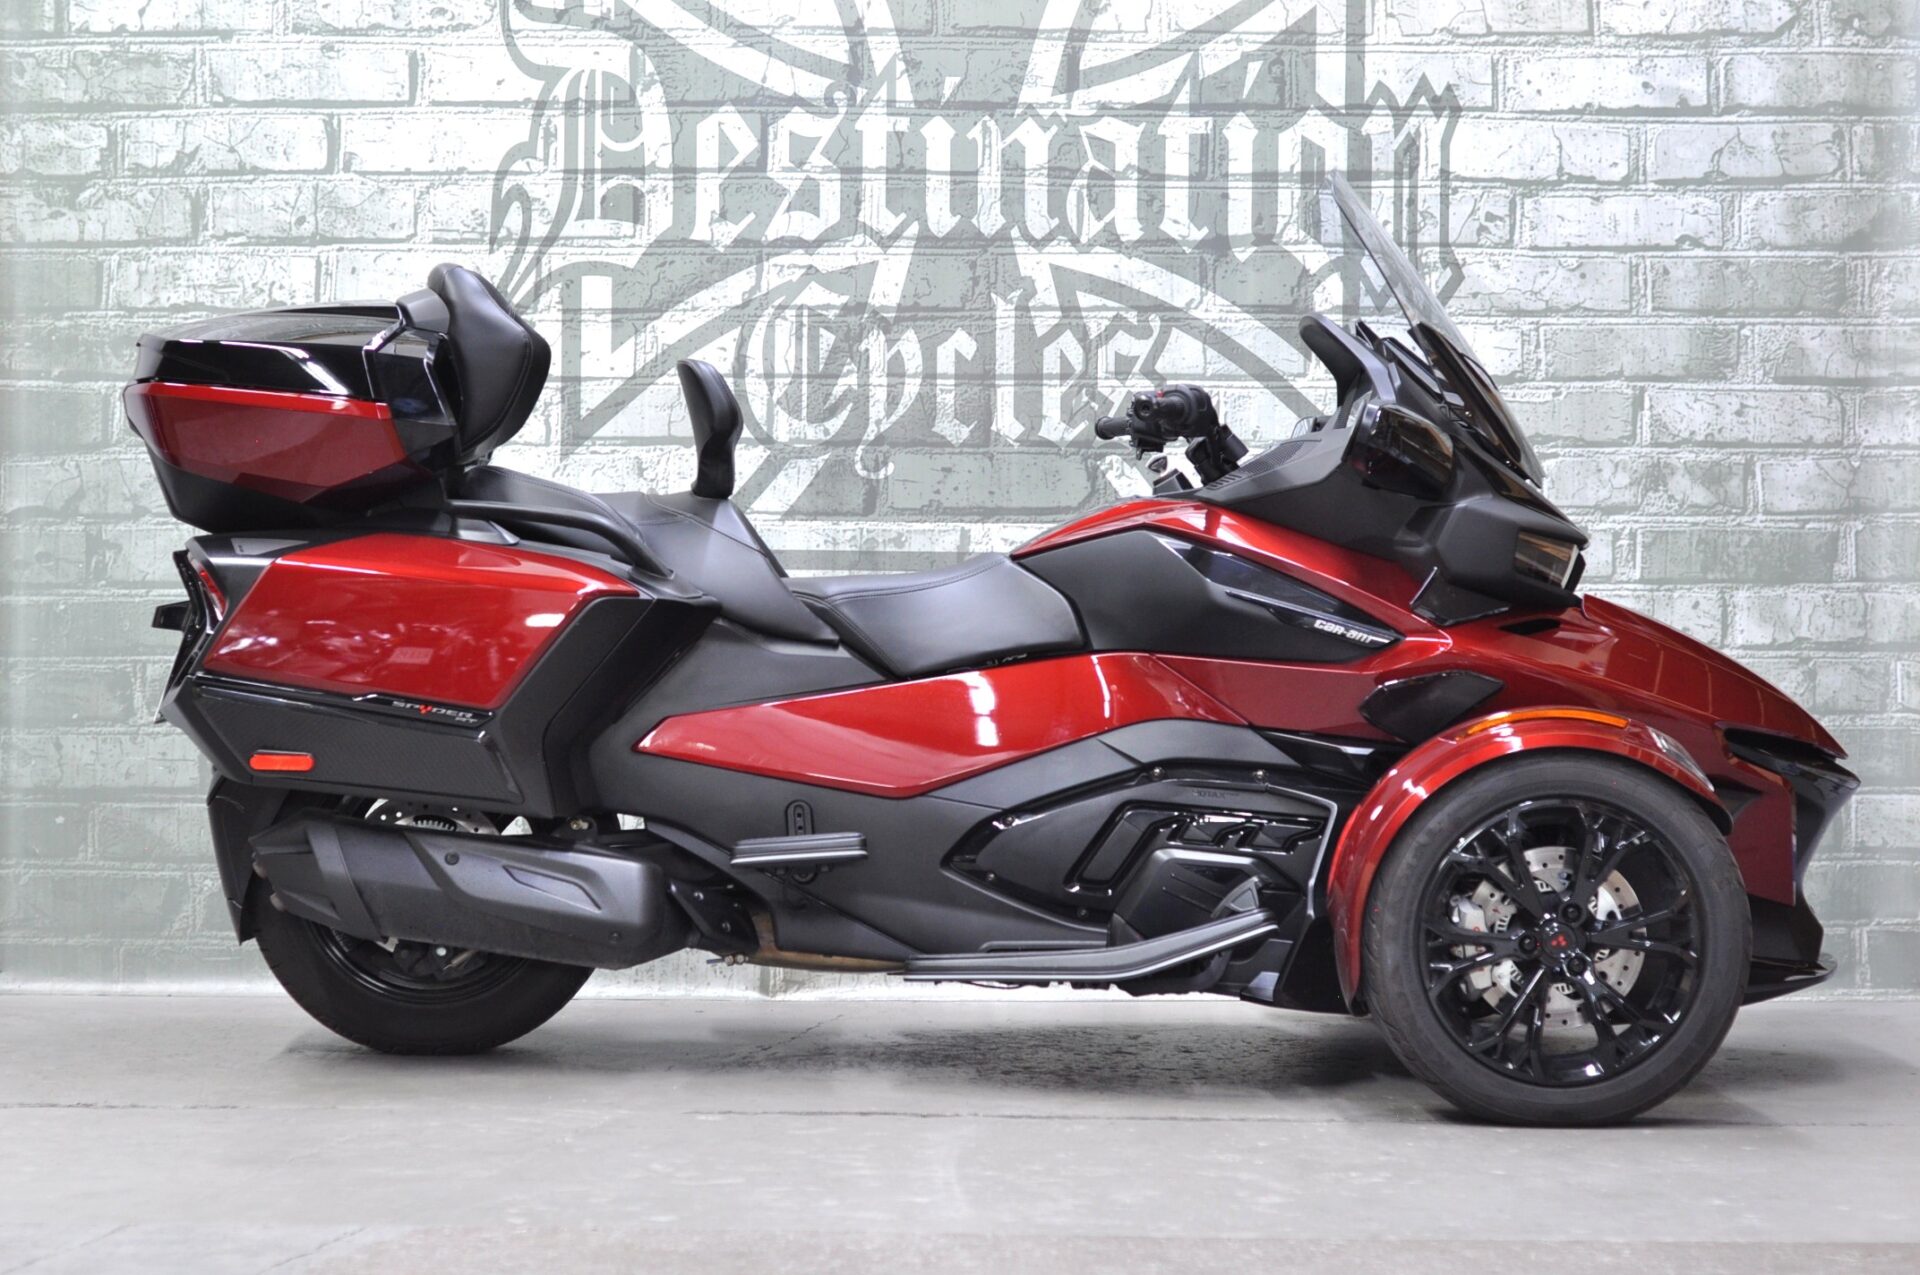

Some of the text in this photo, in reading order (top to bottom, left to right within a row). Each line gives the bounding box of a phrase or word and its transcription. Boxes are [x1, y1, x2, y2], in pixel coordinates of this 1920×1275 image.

[500, 62, 1452, 298] Destination
[744, 281, 1162, 479] Cycles
[391, 700, 473, 718] SPYDER
